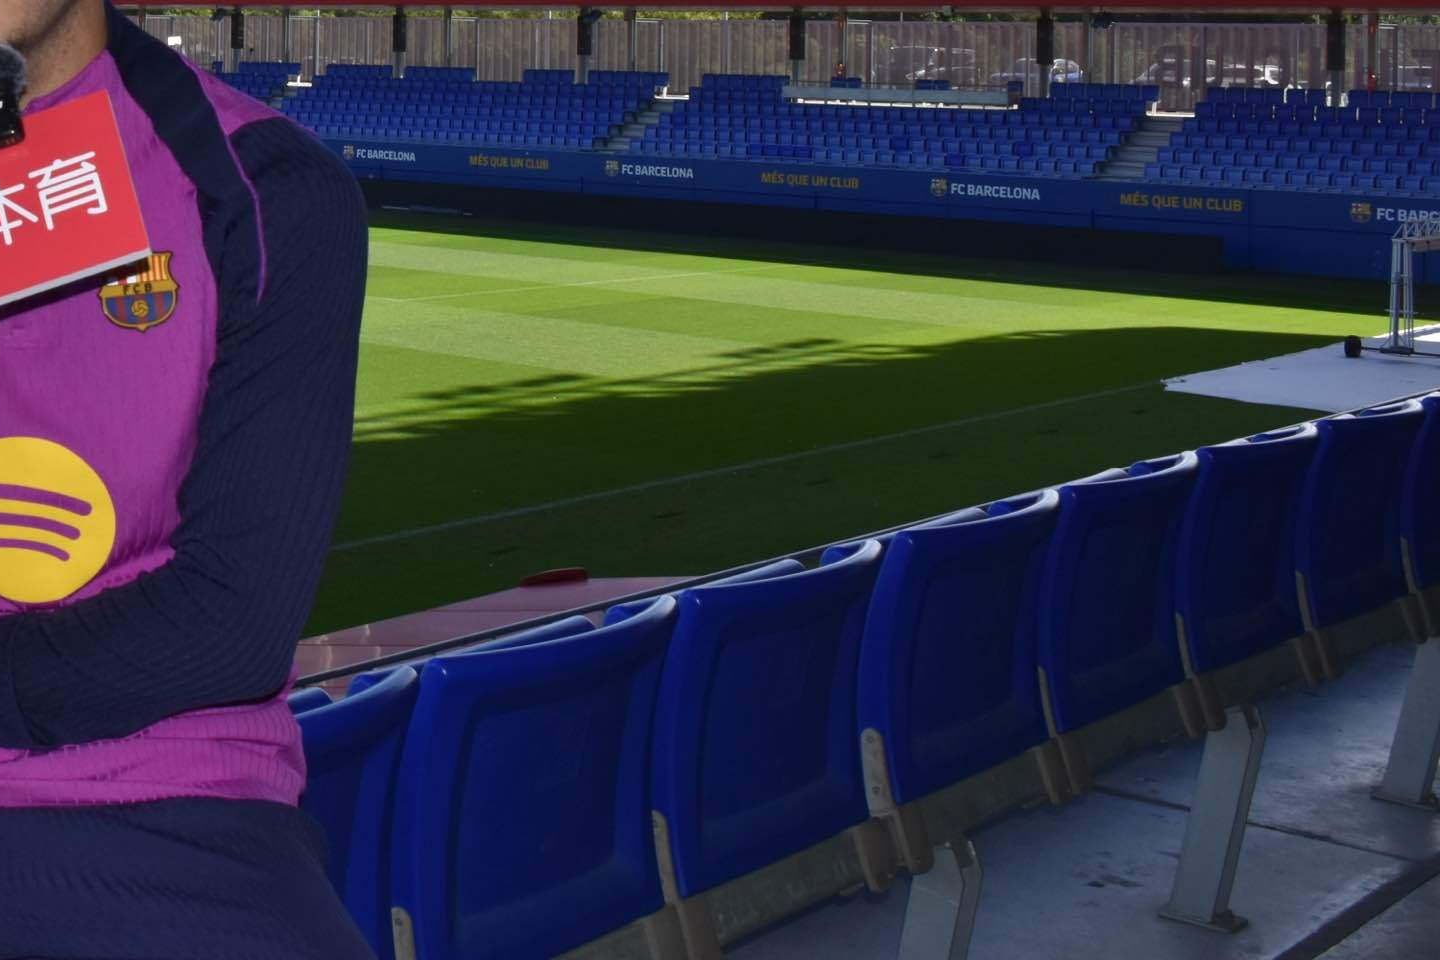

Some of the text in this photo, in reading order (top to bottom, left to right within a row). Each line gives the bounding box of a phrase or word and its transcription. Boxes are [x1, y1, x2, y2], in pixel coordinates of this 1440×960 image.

[356, 149, 416, 162] FC BARCELONA
[490, 157, 509, 168] QUE
[622, 164, 694, 179] FC BARCELONA
[761, 171, 859, 189] MÉS QUE UN CLUB
[951, 183, 1041, 200] FC BARCELONA
[1120, 191, 1243, 212] MÉS QUE UN CLUB
[1376, 207, 1395, 221] FC
[122, 282, 153, 296] FCB
